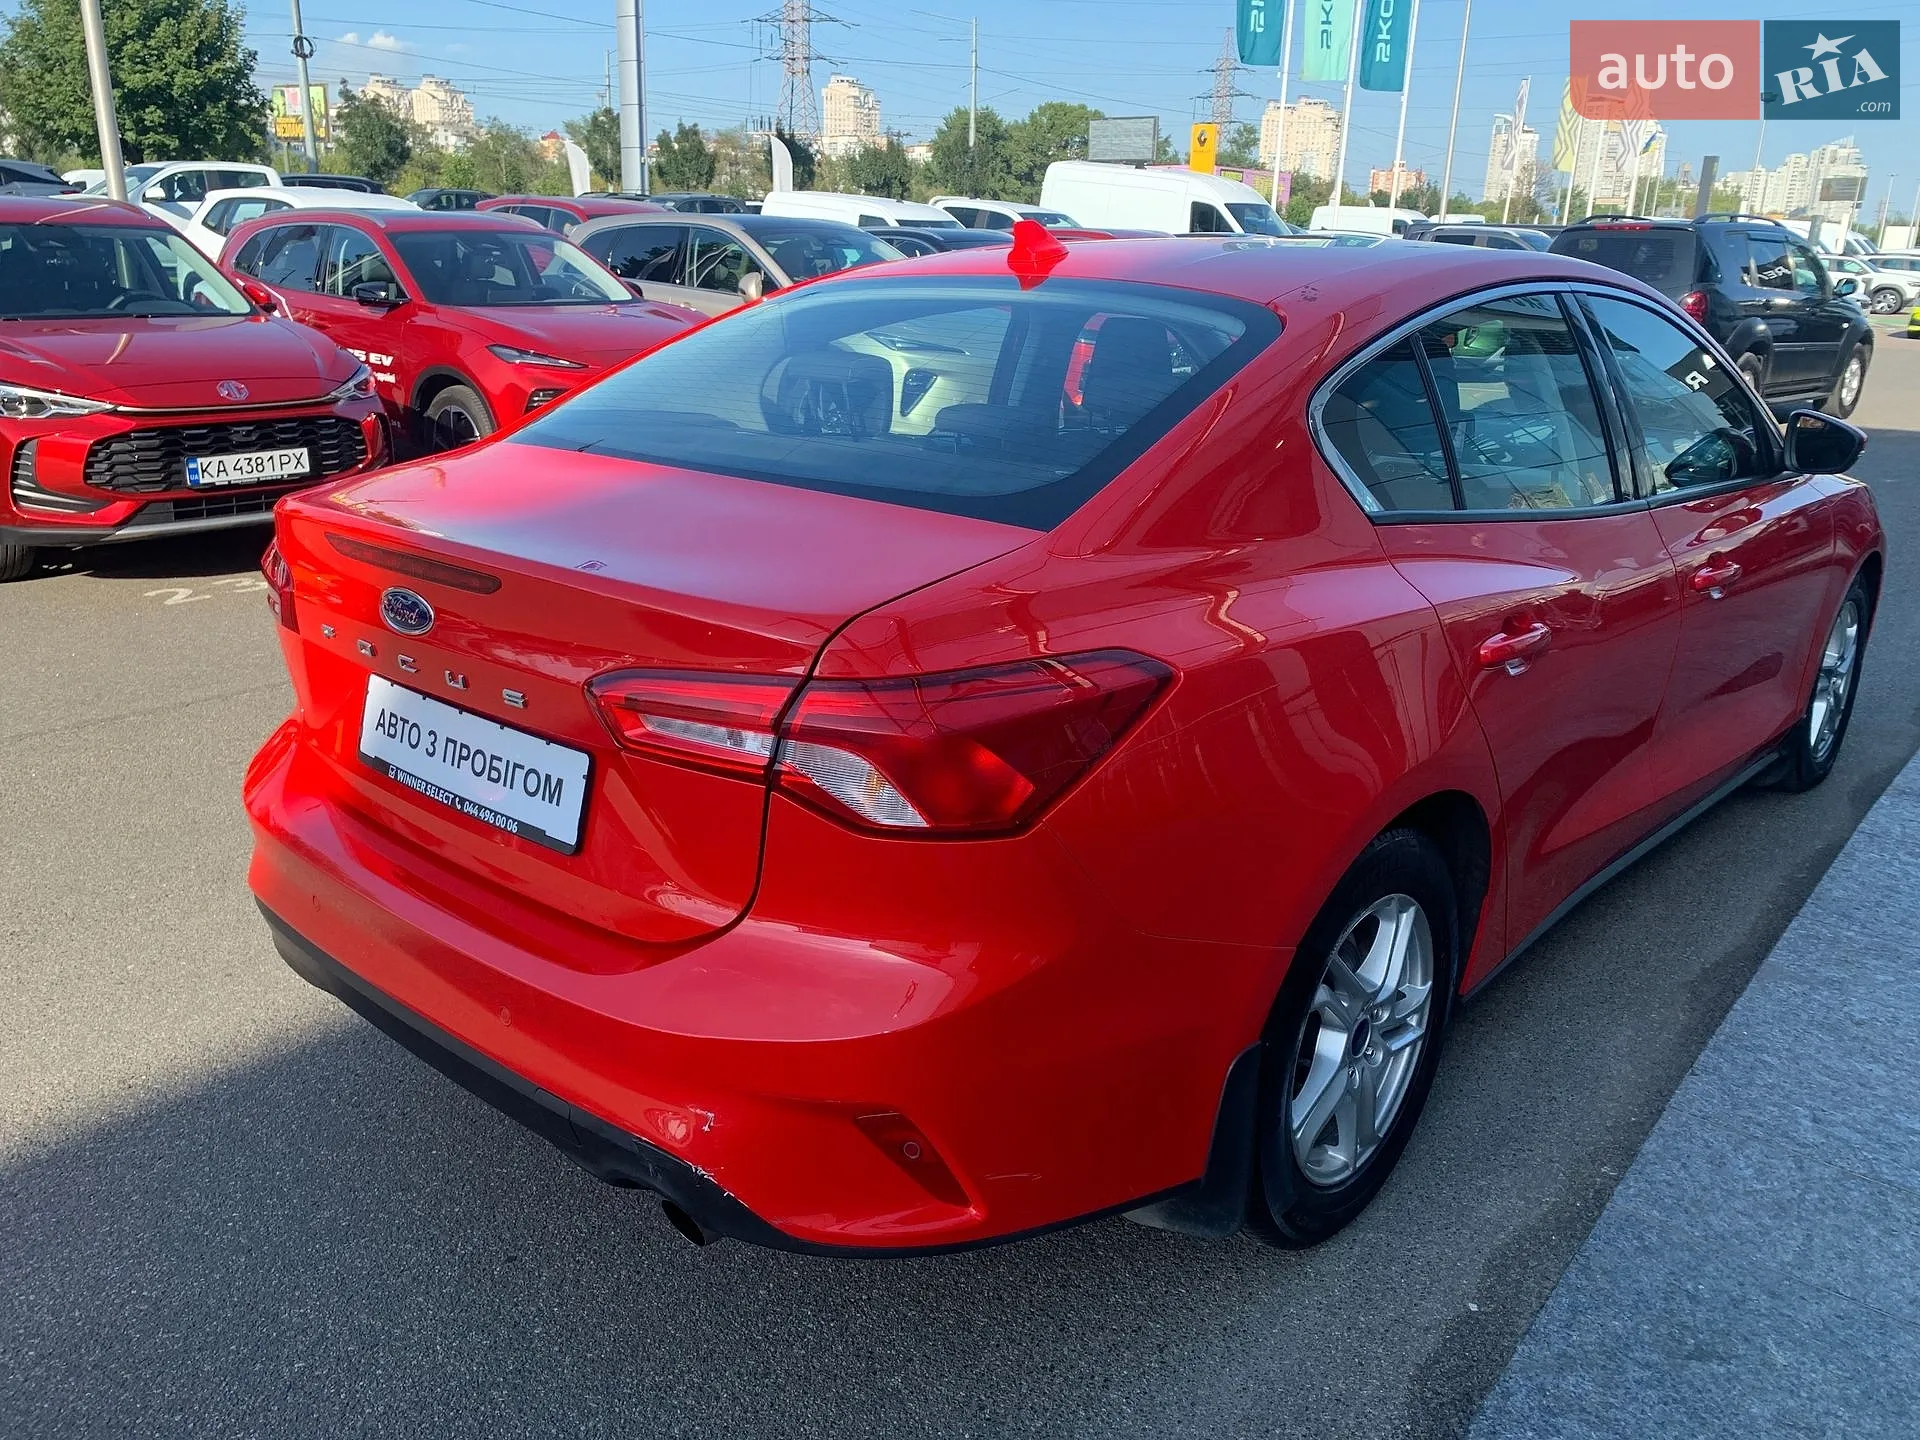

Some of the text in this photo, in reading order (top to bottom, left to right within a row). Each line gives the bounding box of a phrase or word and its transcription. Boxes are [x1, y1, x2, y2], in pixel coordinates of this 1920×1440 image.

[369, 352, 394, 367] EV
[232, 455, 275, 476] 4381
[383, 595, 419, 625] Ford
[321, 623, 525, 709] FOCUS
[375, 707, 564, 807] АВТО З ПРОБІГОМ
[397, 769, 518, 834] WINNER SELECT 044 496 00 06
